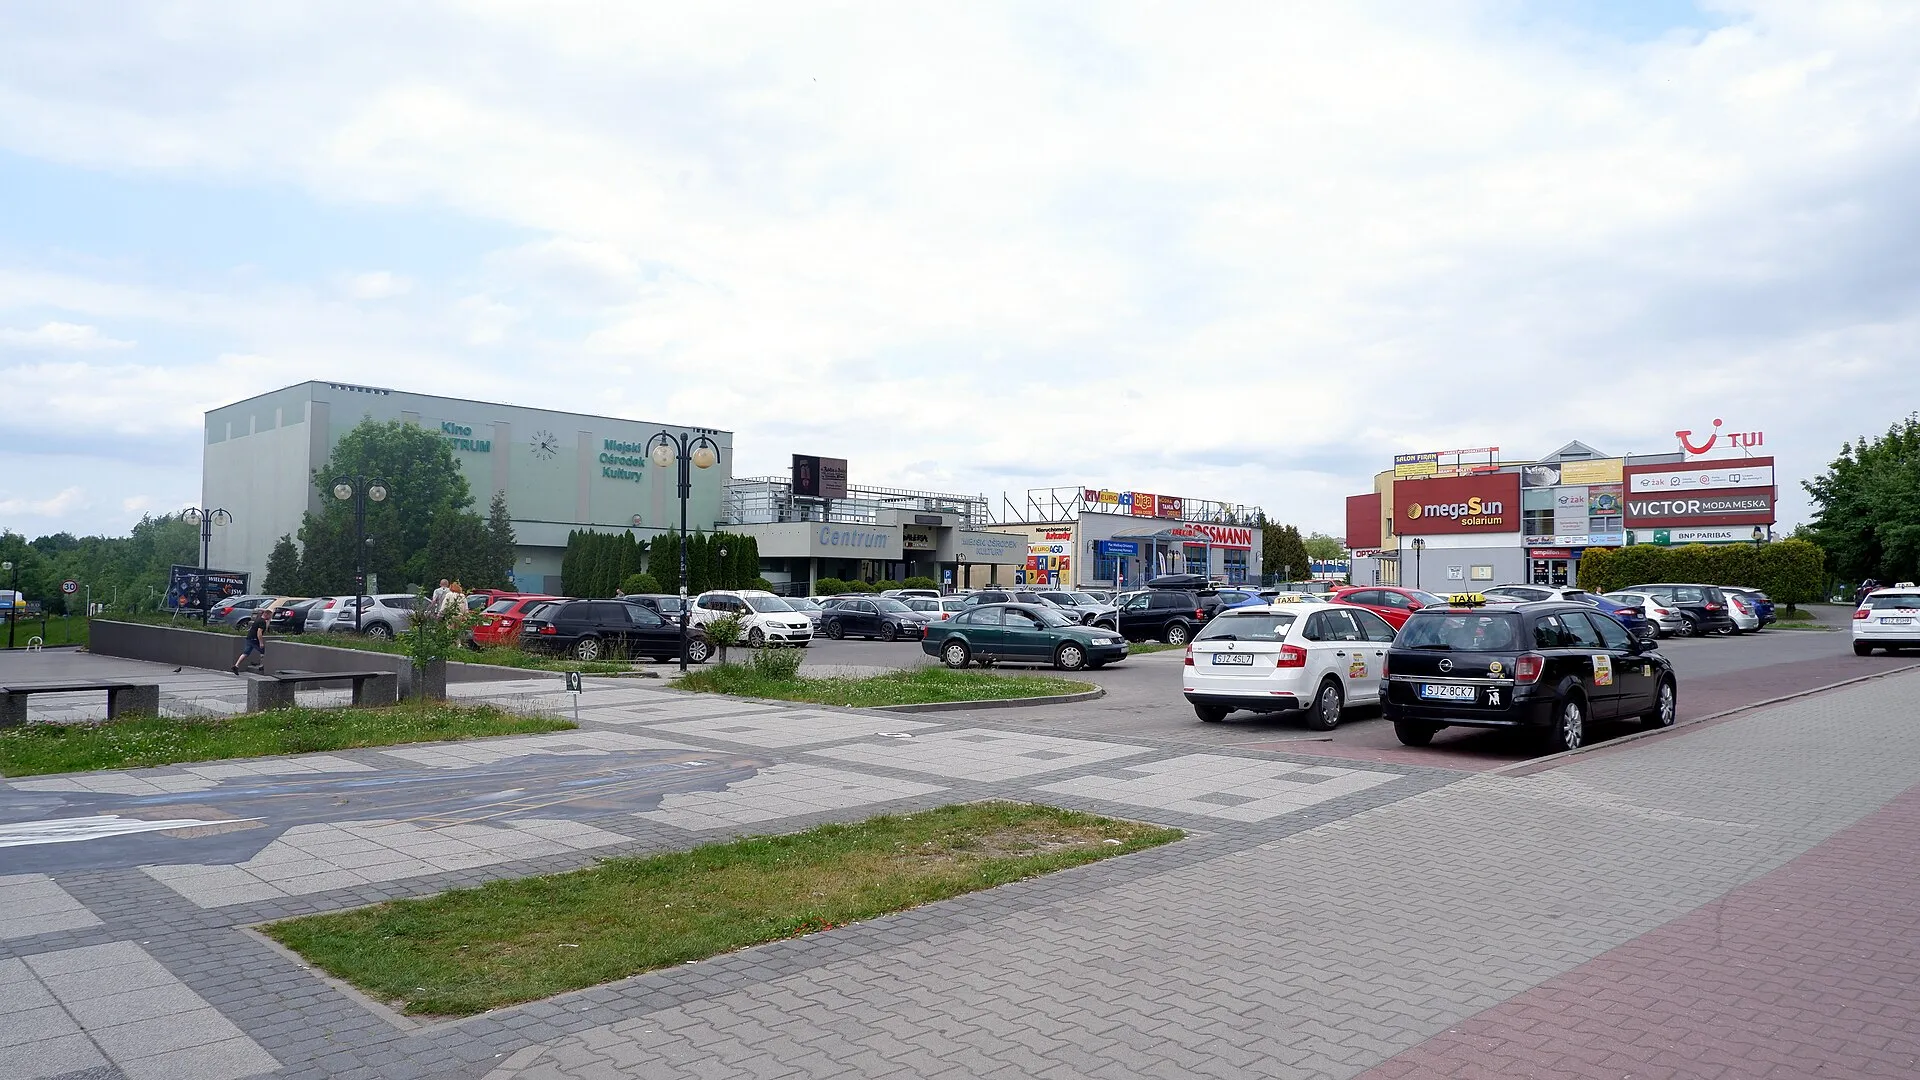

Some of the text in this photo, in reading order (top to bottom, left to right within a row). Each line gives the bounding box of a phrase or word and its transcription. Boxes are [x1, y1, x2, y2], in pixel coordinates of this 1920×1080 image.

[441, 421, 472, 436] Kino
[453, 438, 491, 452] TRUM
[604, 438, 641, 454] Miejski
[1728, 431, 1763, 447] TUI
[599, 452, 645, 467] Ośrodek
[602, 466, 642, 482] Kultury
[1101, 493, 1118, 502] EURO
[1424, 496, 1503, 520] megaSun
[1628, 499, 1766, 516] VICTOR MODA MĘSKA
[1461, 515, 1503, 526] solarium
[819, 525, 889, 548] Centrum
[1697, 531, 1732, 539] PARIBAS
[1278, 596, 1294, 604] TAXI
[1217, 654, 1230, 662] SJZ
[1427, 685, 1474, 697] SJZ 8CK7
